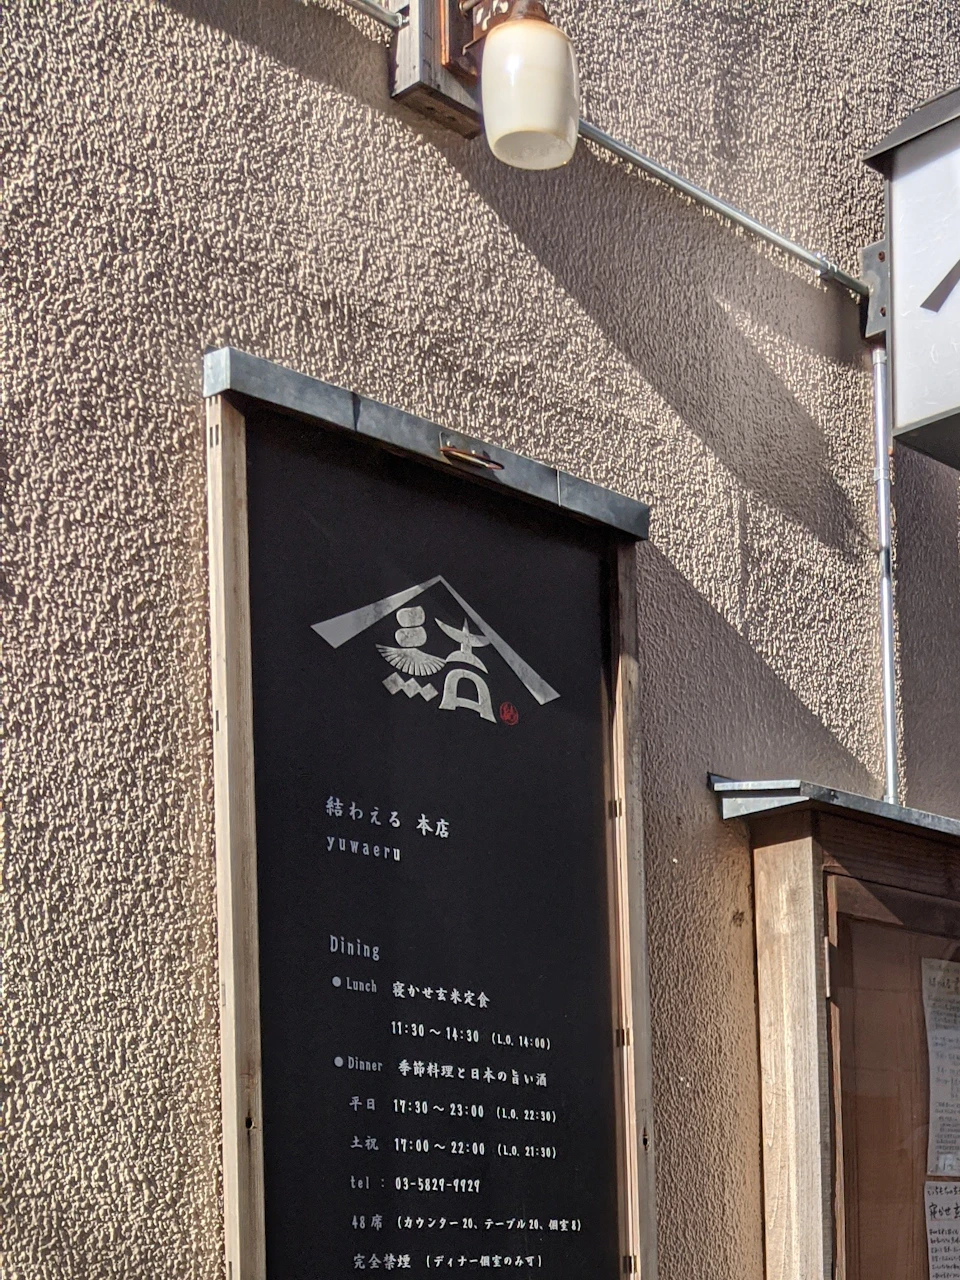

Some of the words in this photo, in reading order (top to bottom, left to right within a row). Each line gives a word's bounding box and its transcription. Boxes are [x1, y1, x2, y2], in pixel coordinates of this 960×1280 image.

[325, 795, 401, 828] 結わえる
[416, 813, 450, 838] 本店
[326, 833, 401, 862] yuwaeru
[329, 934, 380, 962] Dining
[346, 976, 377, 993] Lunch
[392, 980, 491, 1009] 寝かせ玄米定食
[347, 1055, 383, 1072] Dinner
[348, 1095, 376, 1112] 平日
[350, 1135, 379, 1151] 土祝
[350, 1175, 370, 1190] tel
[395, 1176, 480, 1193] 03-5829-9929
[353, 1252, 412, 1271] 完全禁煙
[426, 1254, 542, 1269] (ディナー個室のみ可)
